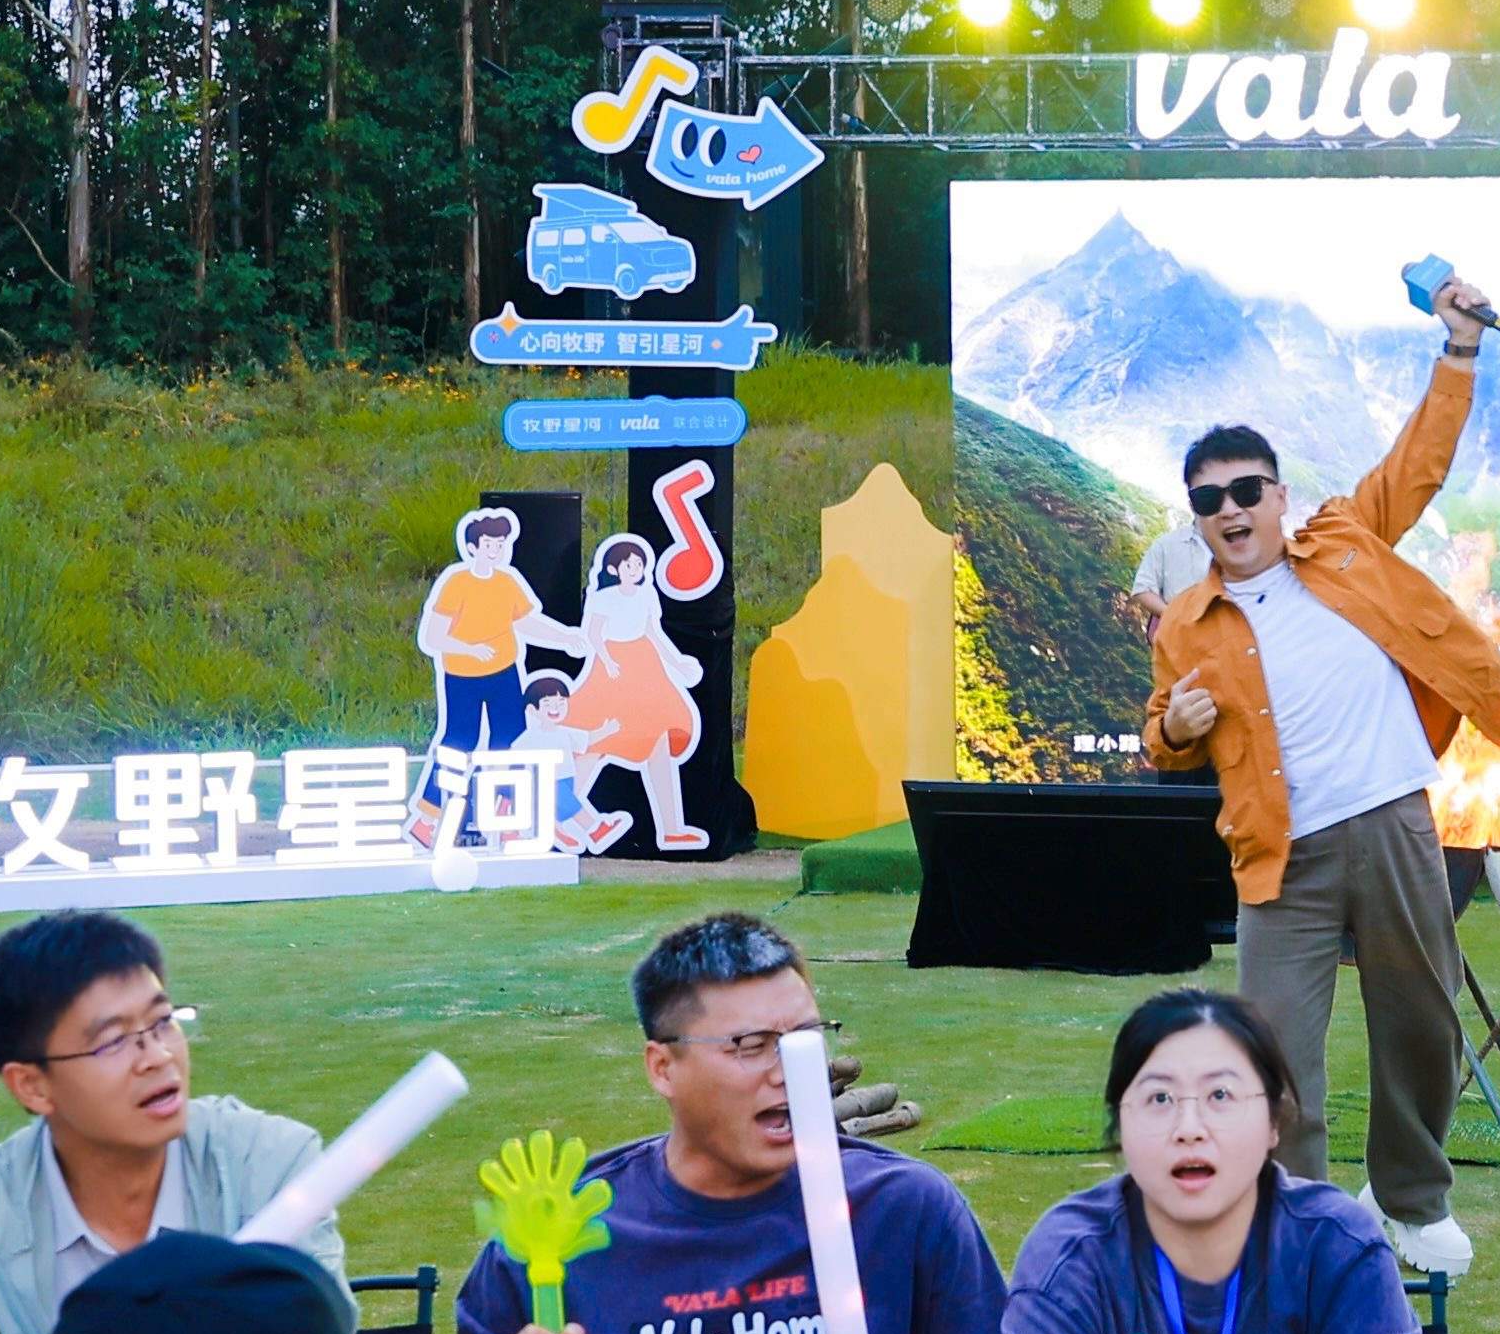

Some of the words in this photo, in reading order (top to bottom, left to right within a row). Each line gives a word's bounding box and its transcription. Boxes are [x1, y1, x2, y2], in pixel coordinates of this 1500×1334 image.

[1134, 26, 1461, 141] vala
[746, 164, 788, 184] home
[520, 332, 605, 354] 心向牧野
[617, 333, 704, 355] 智引星河
[522, 417, 602, 434] 牧野星河
[619, 414, 661, 432] vala
[663, 1287, 742, 1314] VALA
[745, 1274, 807, 1303] LIFE
